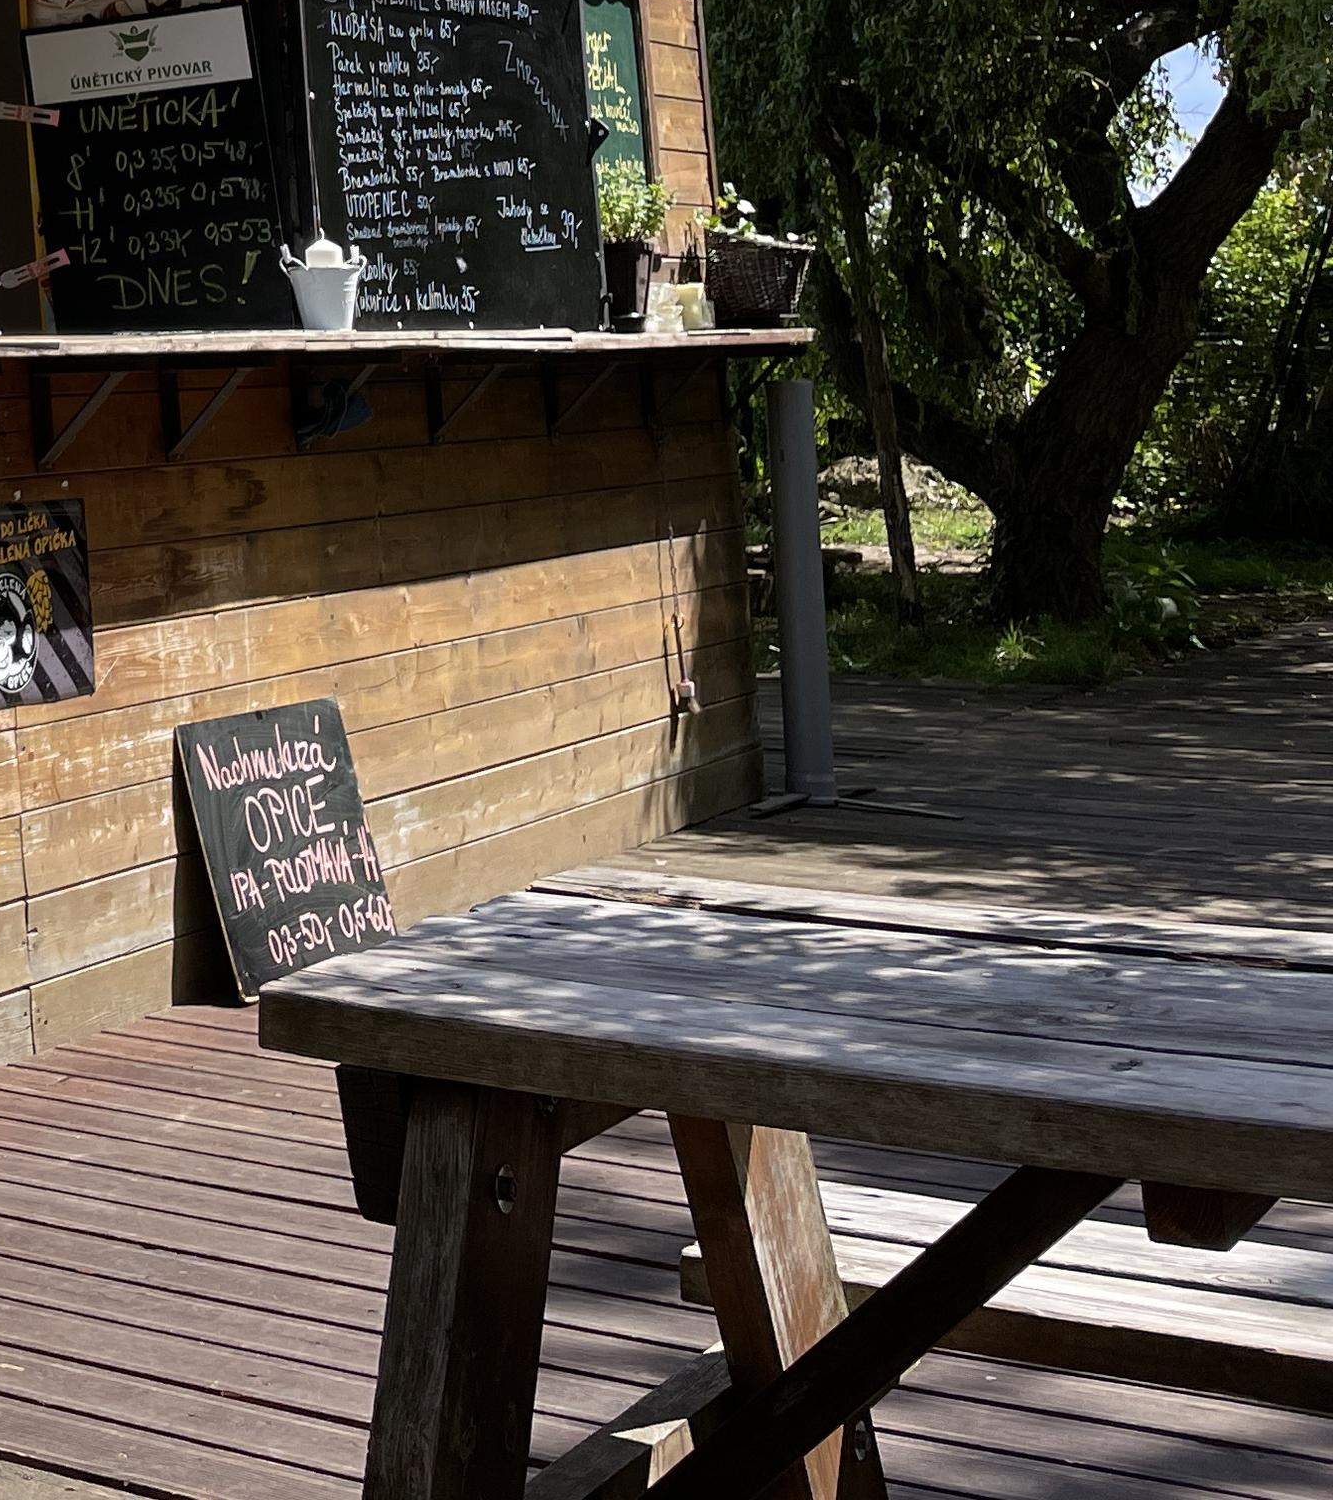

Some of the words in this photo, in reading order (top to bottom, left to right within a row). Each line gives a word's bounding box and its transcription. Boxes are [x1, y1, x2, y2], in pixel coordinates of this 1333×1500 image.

[330, 10, 384, 45] KLOBÁSA
[326, 41, 364, 74] Párek
[70, 66, 143, 91] ÚNĚTICKÝ
[147, 60, 213, 79] PIVOVAR
[345, 190, 411, 220] UTOPENEC
[0, 522, 14, 539] DO
[17, 512, 48, 533] LÍČKA
[34, 527, 76, 555] OPIČKA
[196, 715, 336, 791] Nachmelená
[244, 774, 336, 853] OPICE
[230, 868, 265, 911] IPA
[264, 821, 355, 902] POLOTMAVÁ
